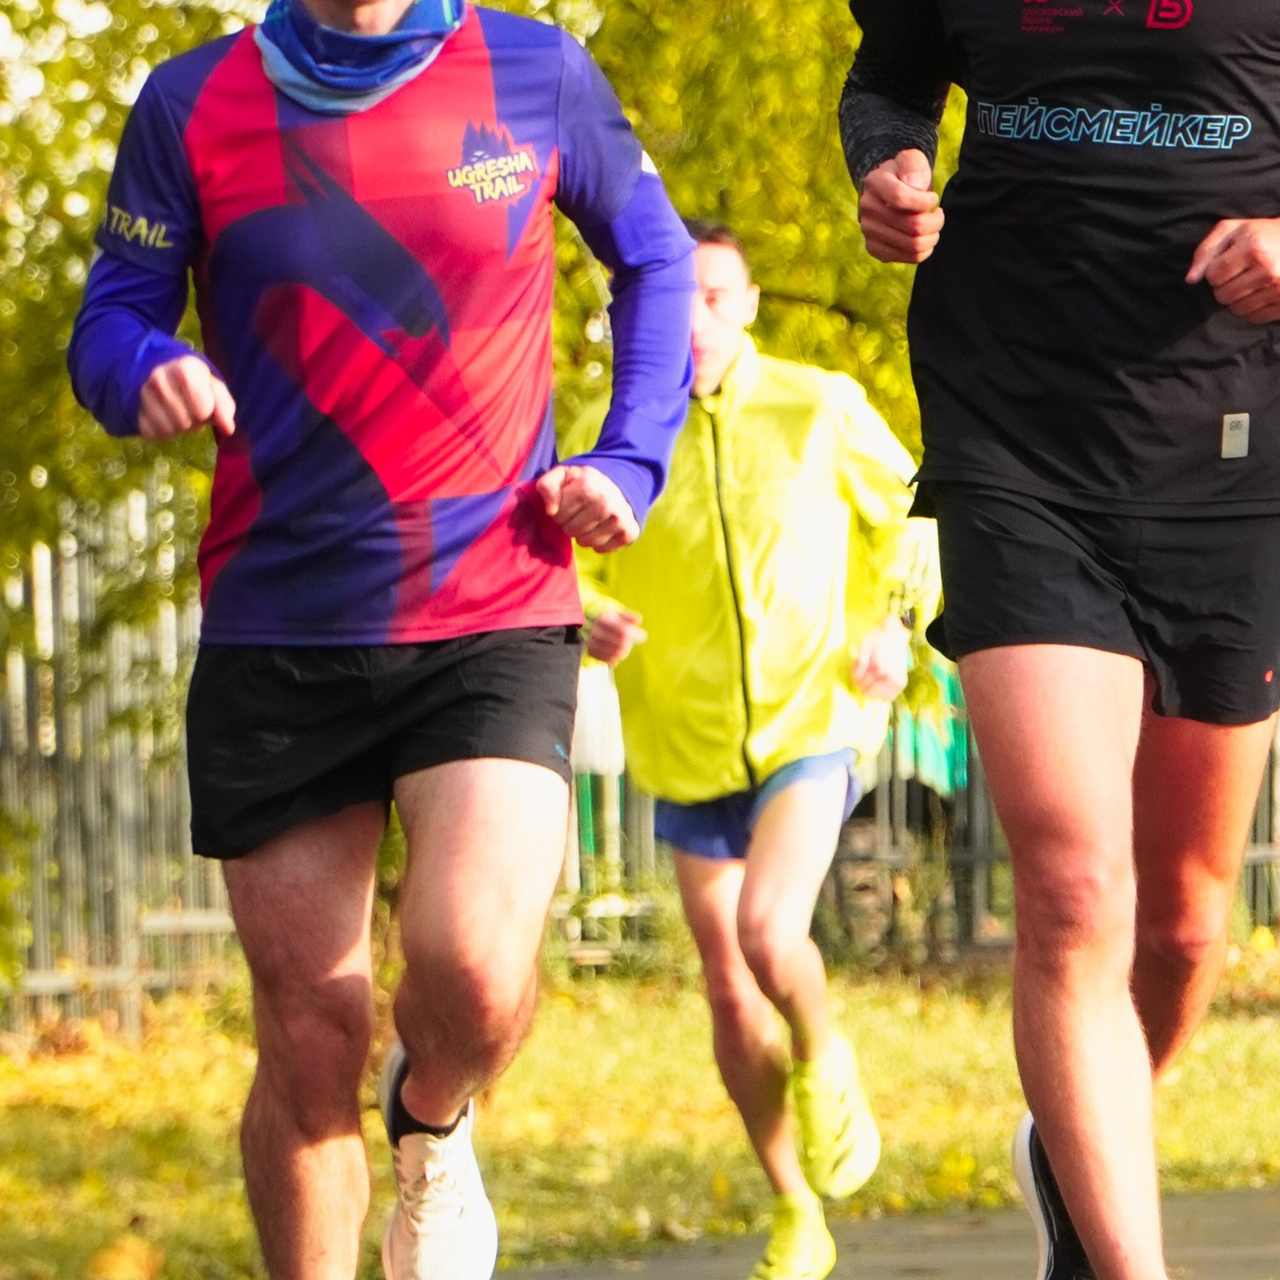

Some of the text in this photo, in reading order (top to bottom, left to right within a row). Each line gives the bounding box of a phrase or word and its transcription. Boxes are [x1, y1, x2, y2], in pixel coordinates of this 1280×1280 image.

[978, 97, 1251, 149] ПЕЙСМЕЙКЕР
[447, 151, 533, 188] UGRESHA
[469, 175, 525, 204] TRAIL
[109, 206, 174, 248] TRAIL
